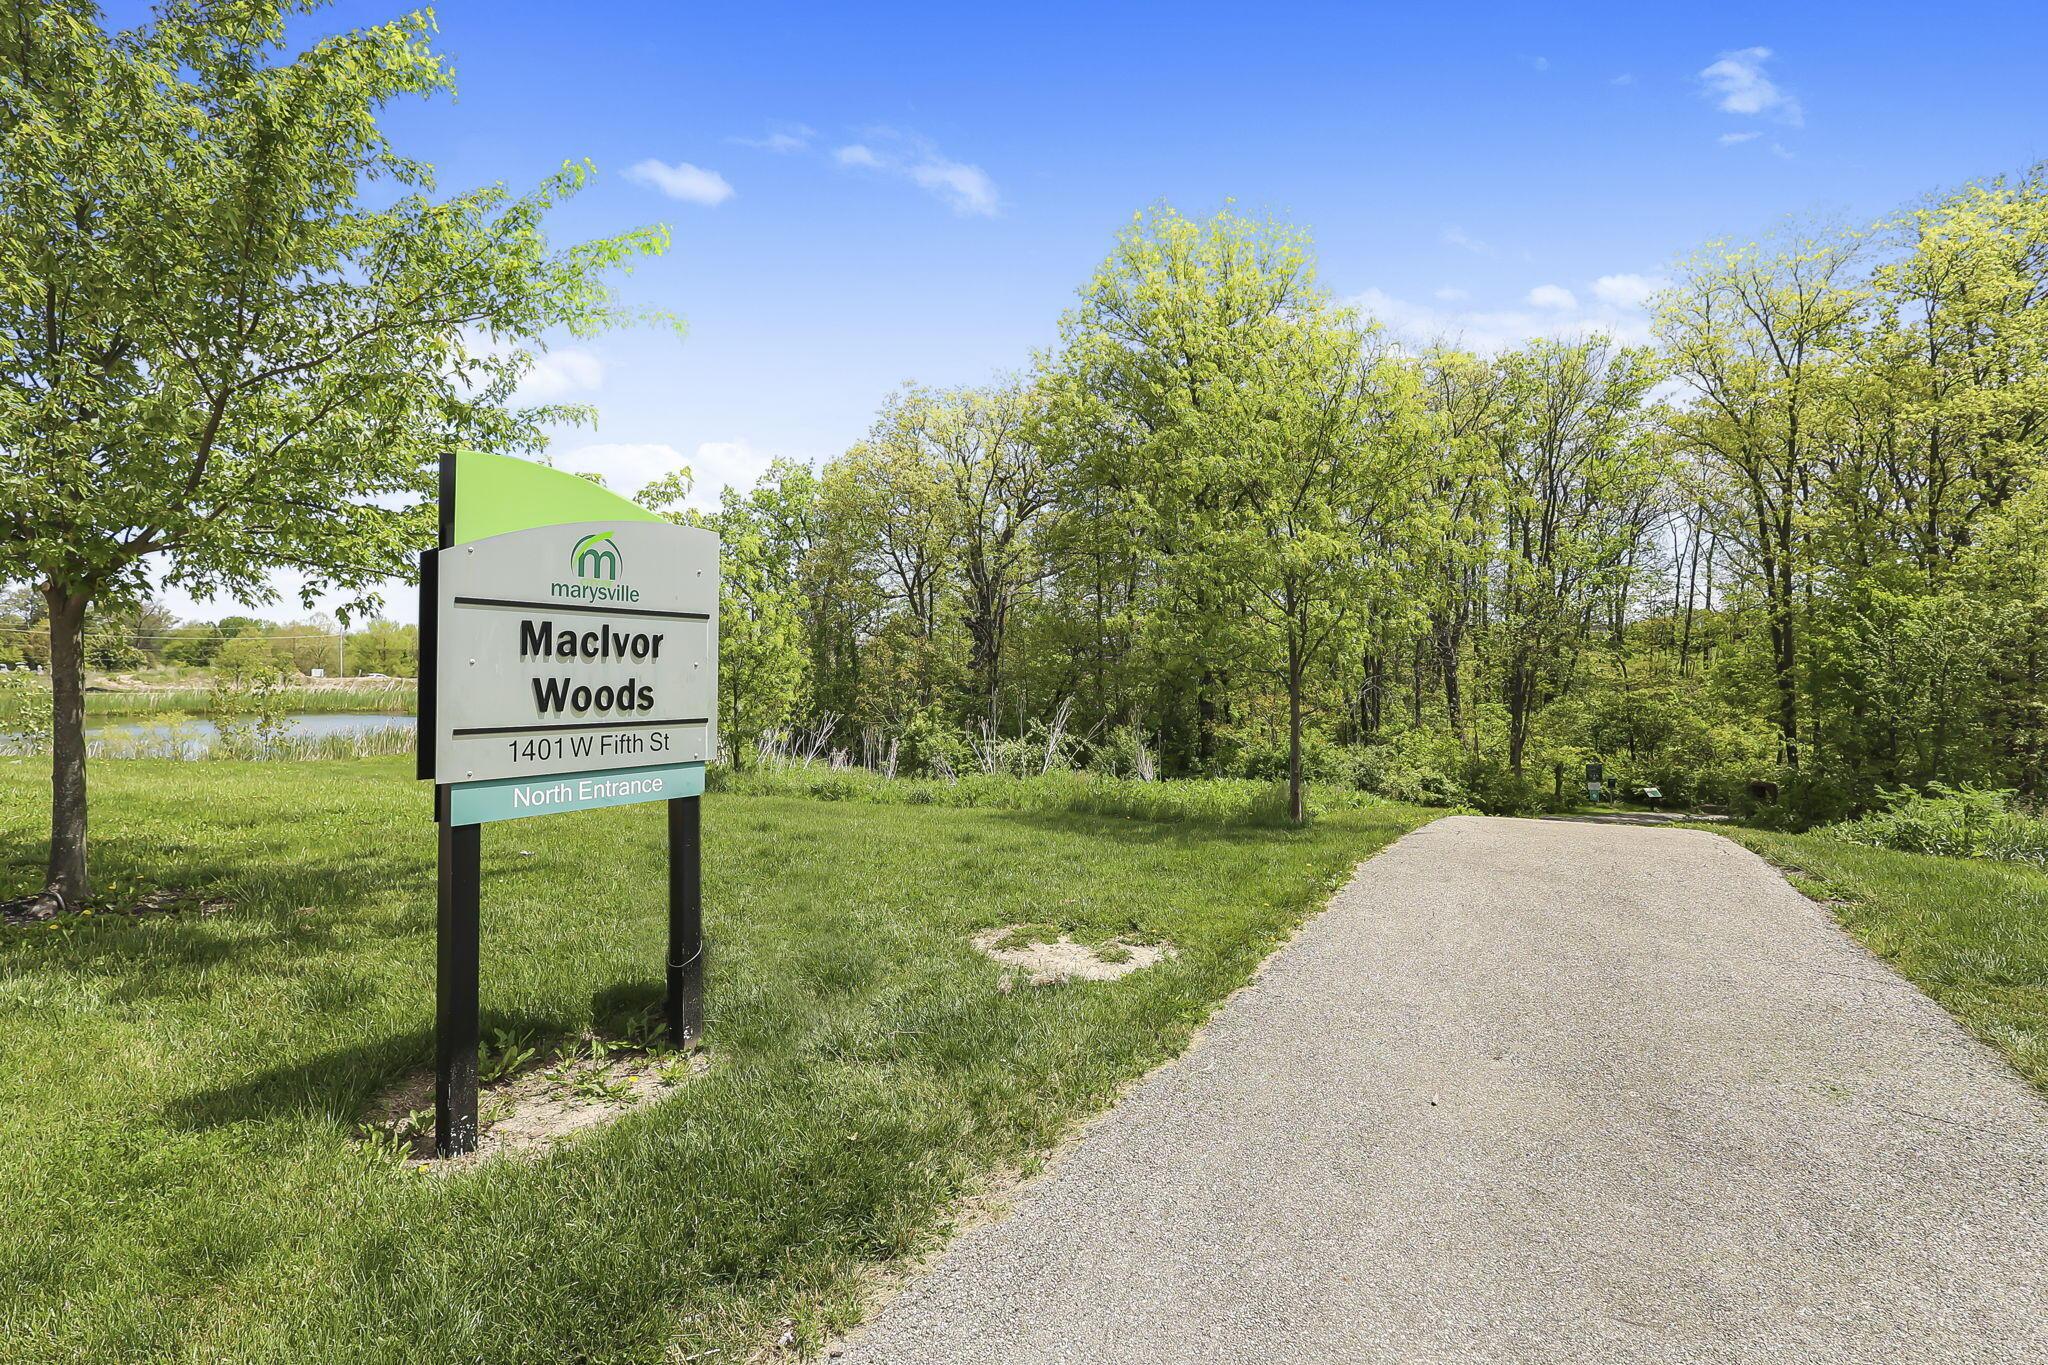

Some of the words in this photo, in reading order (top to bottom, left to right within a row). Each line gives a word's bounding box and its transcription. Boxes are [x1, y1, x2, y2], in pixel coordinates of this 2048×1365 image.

[551, 581, 640, 604] marysville
[520, 620, 664, 659] MacIvor
[532, 677, 655, 713] Woods
[509, 737, 563, 763] 1401
[570, 736, 594, 758] W
[600, 734, 644, 756] Fifth
[649, 731, 670, 752] St
[513, 784, 573, 808] North
[579, 776, 663, 801] Entrance
